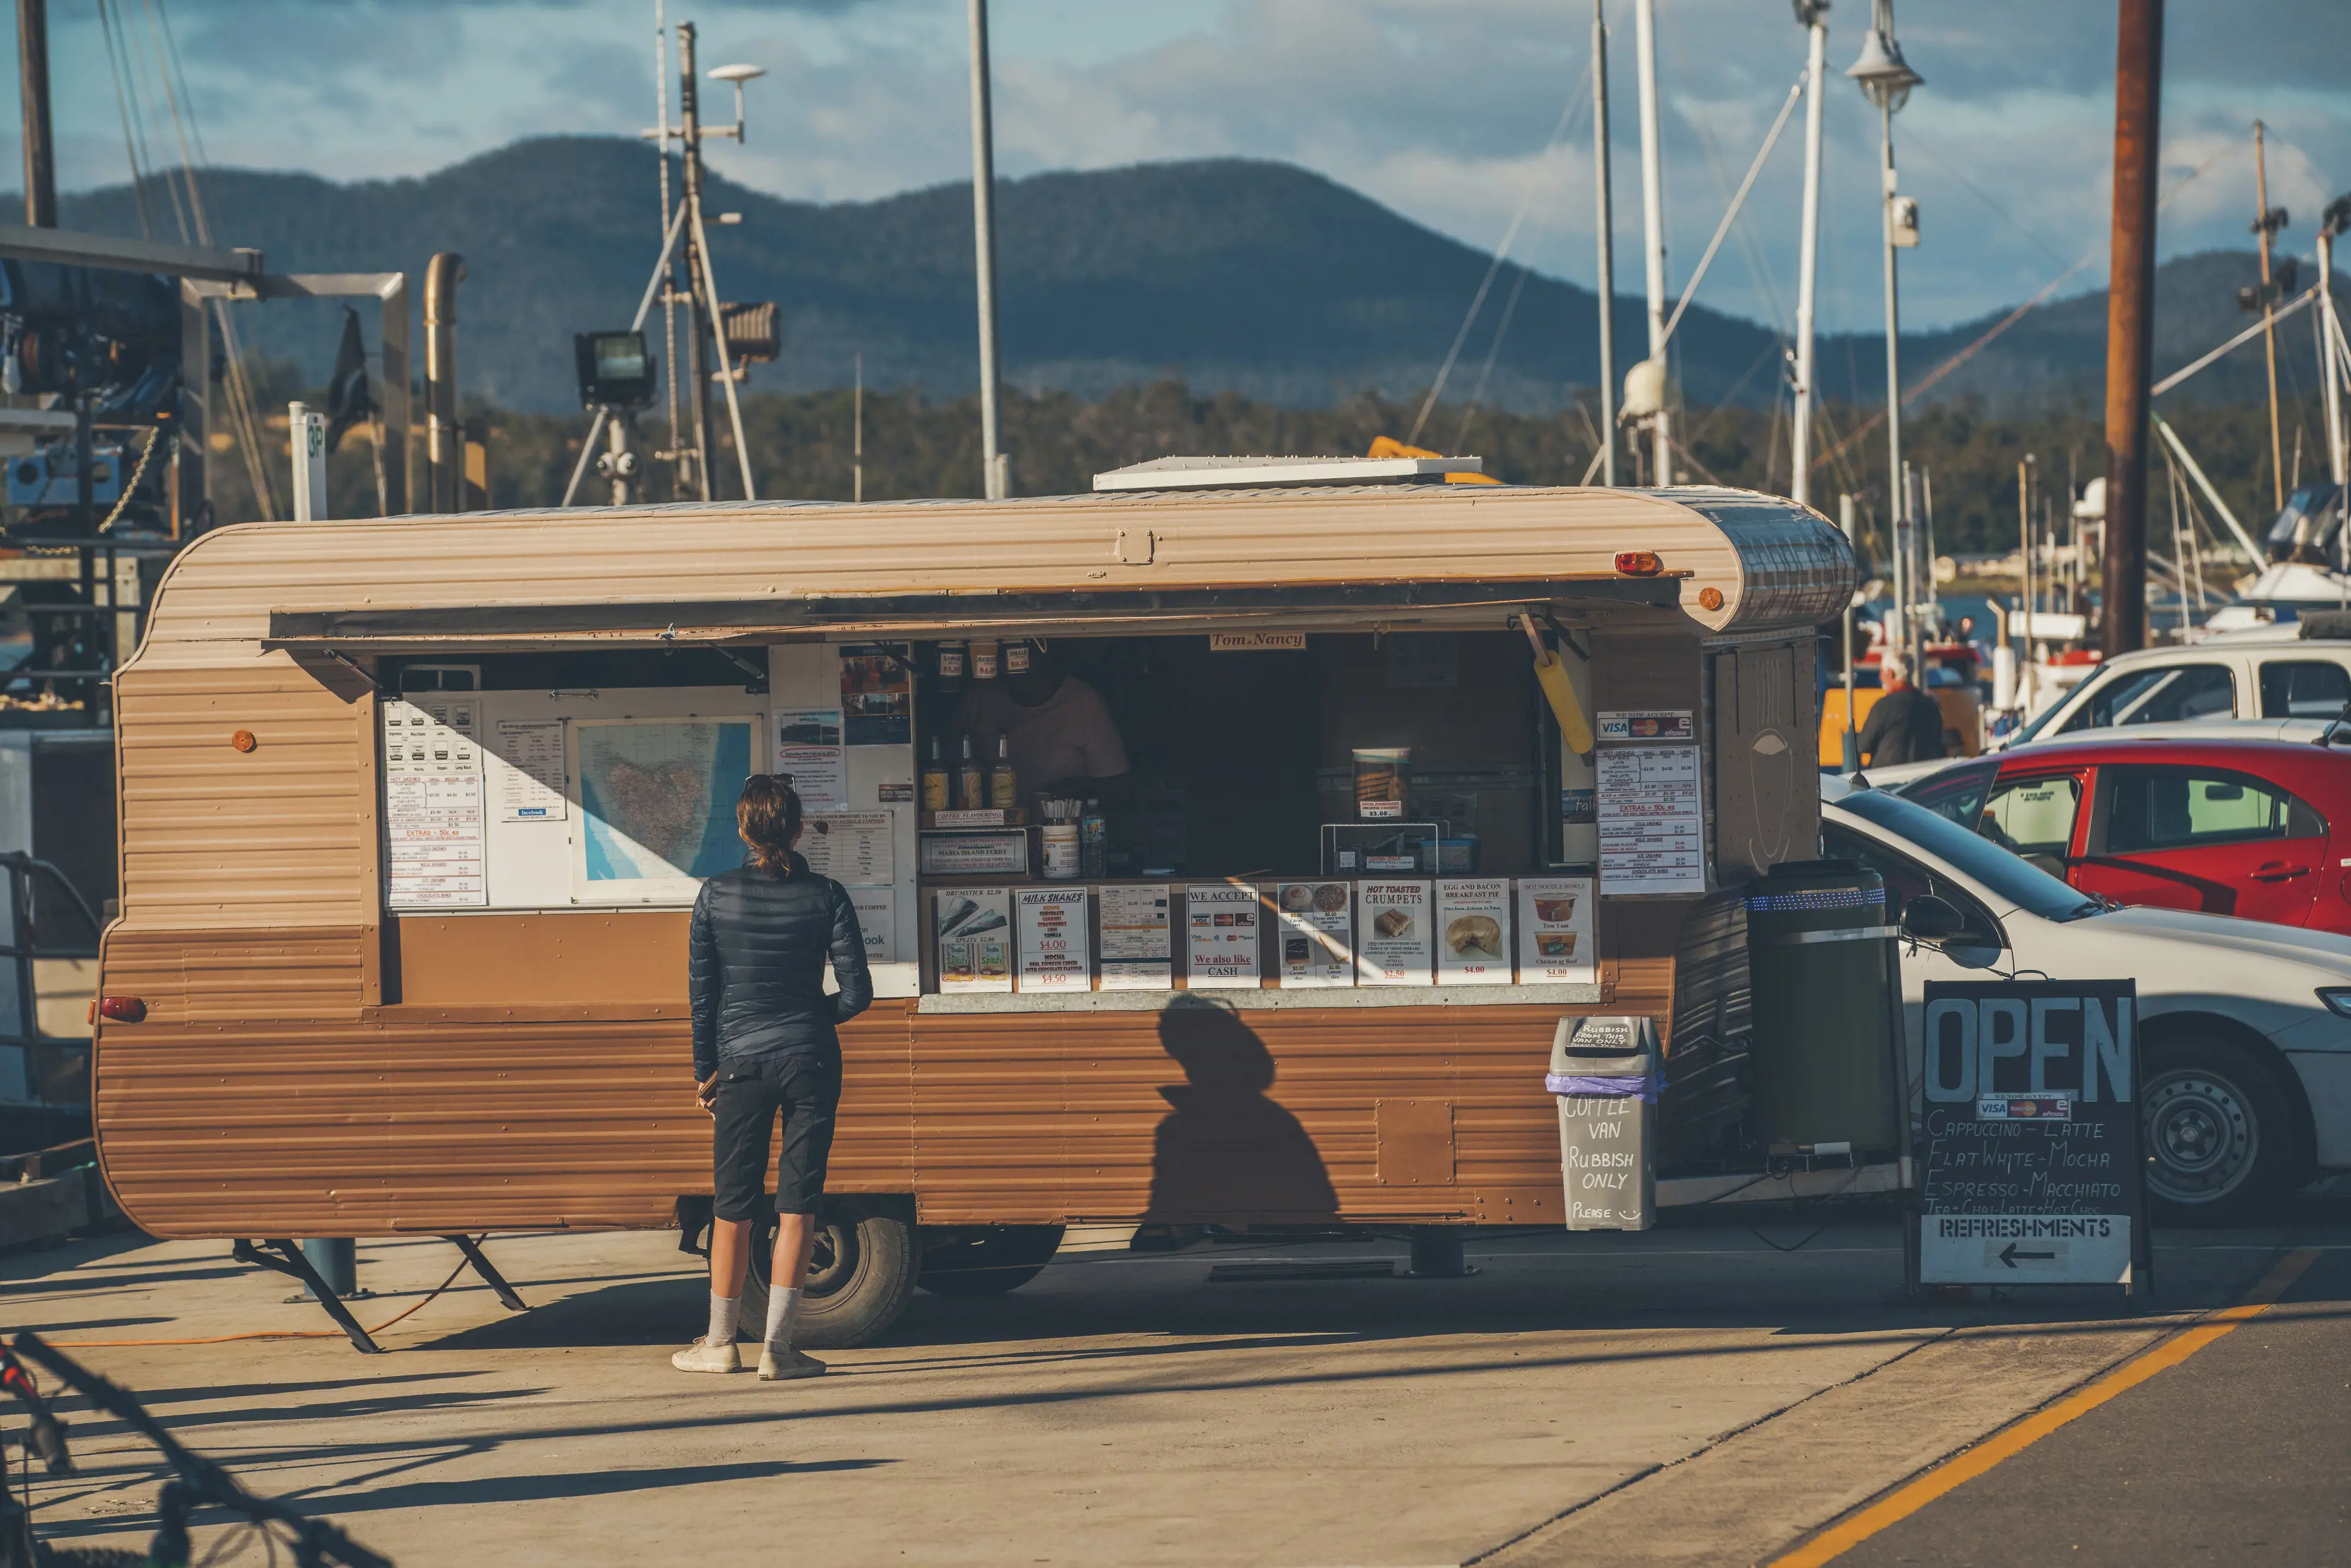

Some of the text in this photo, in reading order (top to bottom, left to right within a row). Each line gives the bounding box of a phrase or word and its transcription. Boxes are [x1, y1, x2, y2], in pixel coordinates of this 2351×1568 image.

[309, 425, 323, 458] 3P
[1213, 633, 1303, 647] Tom Nancy
[1602, 723, 1627, 733] VISA
[1021, 892, 1083, 904] MILK SHAKES
[1190, 891, 1255, 901] WE ACCEPT
[1365, 894, 1423, 904] CRUMPETS
[1041, 940, 1066, 949] $4.00
[947, 957, 969, 966] Splits
[1195, 954, 1251, 963] We also like
[1042, 974, 1066, 983] $4.50
[1208, 967, 1238, 976] CASH
[1925, 997, 2131, 1102] OPEN
[1565, 1094, 1630, 1118] COFFEE
[1981, 1104, 2006, 1113] VISA
[1589, 1121, 1622, 1139] VAN
[1927, 1109, 2105, 1138] CAPPUCCINO LATTE
[1927, 1139, 2110, 1175] FLAT WHITE MOCHA
[1582, 1173, 1628, 1190] ONLY
[1925, 1169, 2120, 1197] ESPRESSO MACCHIATO
[2044, 1199, 2070, 1214] HOT
[2070, 1199, 2101, 1214] CHOC
[1940, 1219, 2110, 1238] REFRESHMENTS
